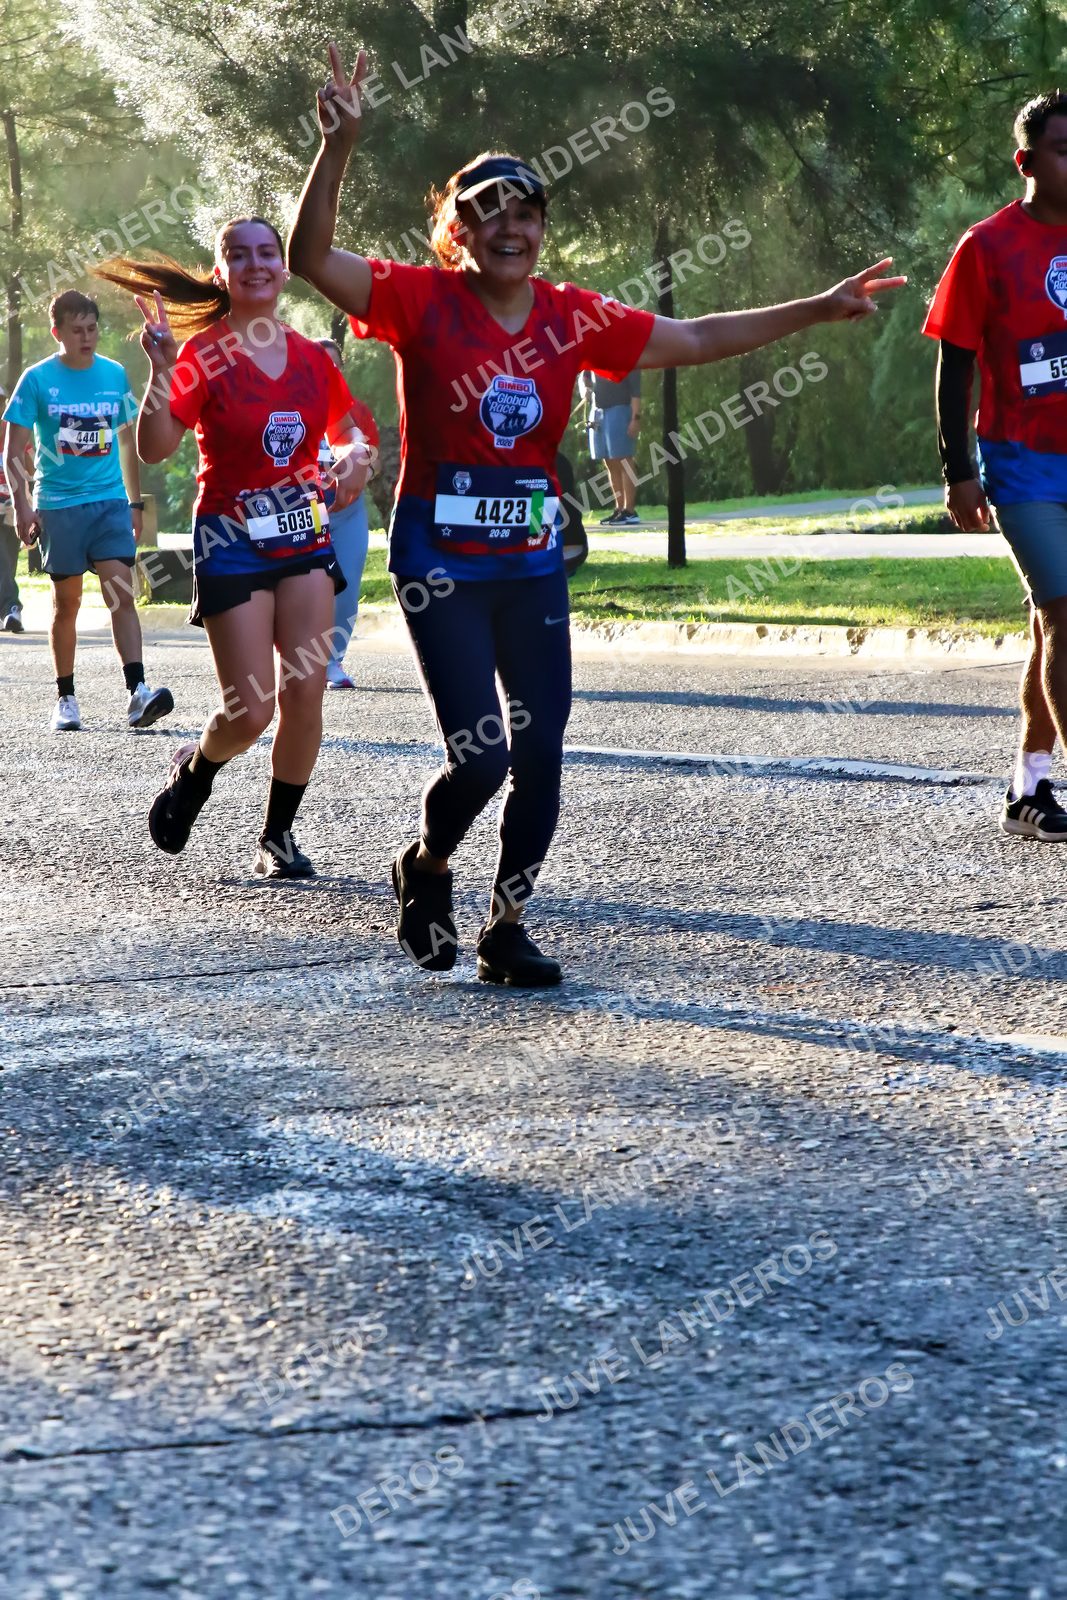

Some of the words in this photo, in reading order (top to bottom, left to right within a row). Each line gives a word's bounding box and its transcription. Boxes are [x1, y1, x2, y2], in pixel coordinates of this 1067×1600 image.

[497, 381, 530, 392] BIMBO
[497, 392, 529, 407] Global
[489, 401, 515, 414] Race
[77, 430, 98, 443] 4441
[475, 499, 527, 524] 4423
[277, 508, 313, 534] 5035
